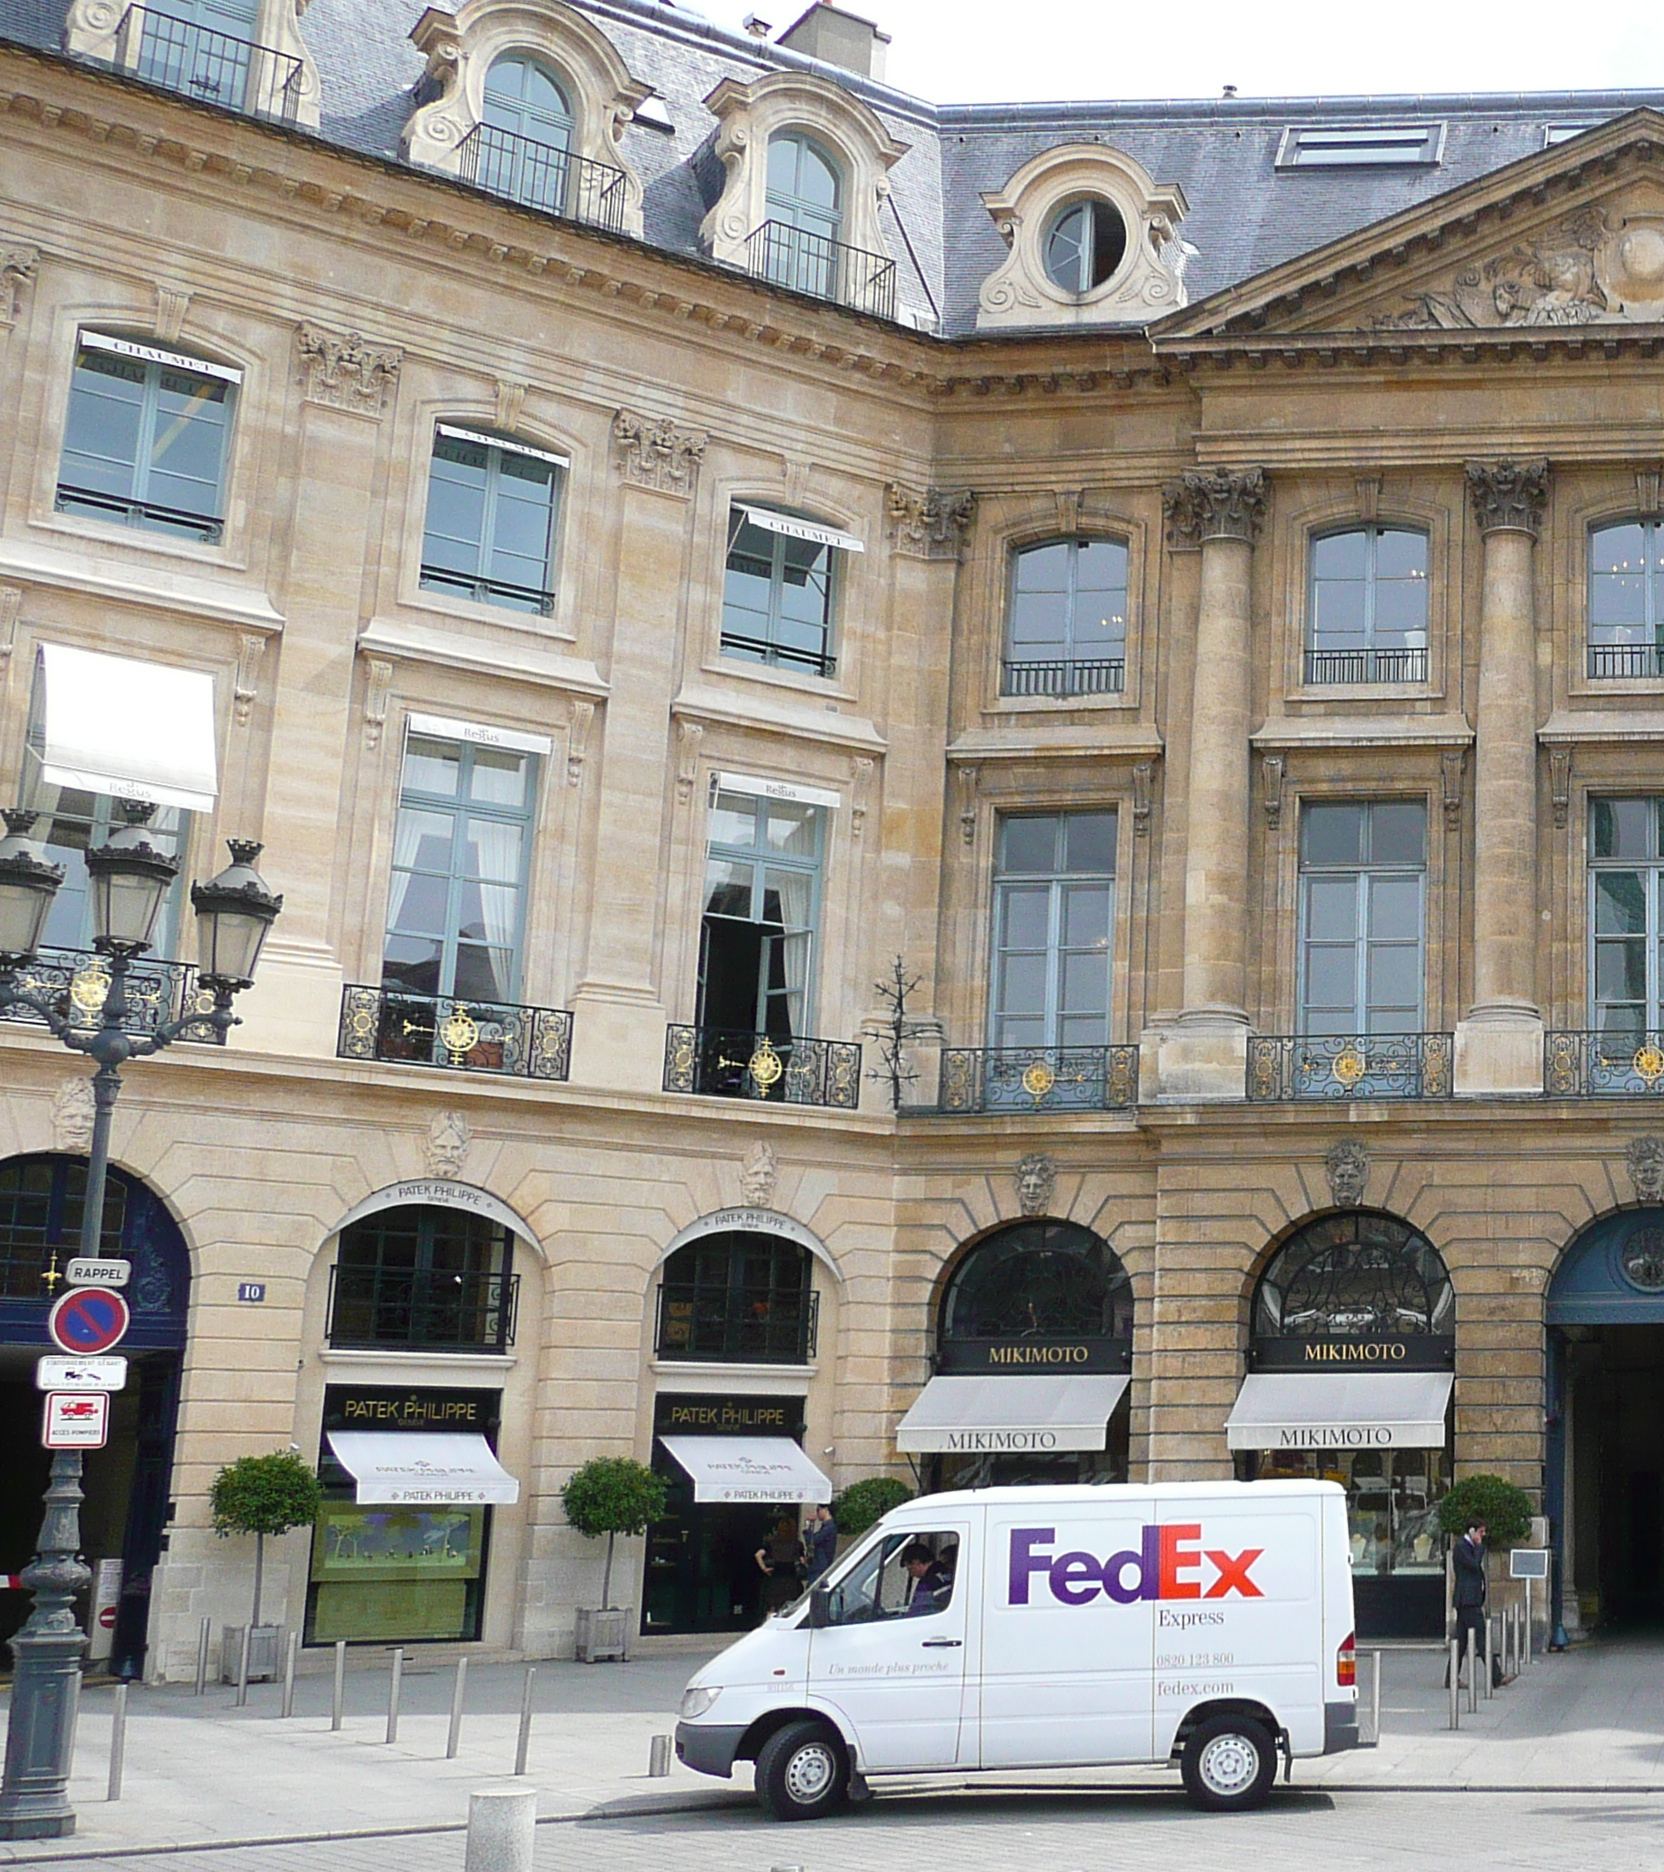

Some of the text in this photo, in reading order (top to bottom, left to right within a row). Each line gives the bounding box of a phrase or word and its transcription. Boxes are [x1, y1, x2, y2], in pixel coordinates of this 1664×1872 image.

[114, 342, 214, 371] CHAUMET
[770, 521, 842, 545] CHAUMET
[109, 782, 152, 798] Regus
[398, 1185, 482, 1206] PATEK PHILIPPE
[715, 1213, 744, 1226] PATEK
[746, 1213, 786, 1230] PHILIPPE
[74, 1268, 123, 1280] RAPPEL
[245, 1285, 260, 1299] 10
[989, 1346, 1089, 1363] MIKIMOTO
[1305, 1343, 1406, 1360] MIKIMOTO
[345, 1401, 478, 1420] PATEK PHILIPPE
[672, 1407, 785, 1425] PATEK PHILIPPE
[947, 1432, 1056, 1449] MIKIMOTO
[1280, 1428, 1392, 1446] MIKIMOTO
[403, 1491, 474, 1500] PATEK PHILIPPE
[734, 1491, 794, 1499] PATEK PHILIPPE
[1008, 1524, 1265, 1605] FedEx
[1158, 1609, 1224, 1630] Express
[1156, 1652, 1234, 1667] 0820 123 800
[828, 1661, 949, 1676] Un monde plus proche
[1158, 1680, 1234, 1696] fedex.com
